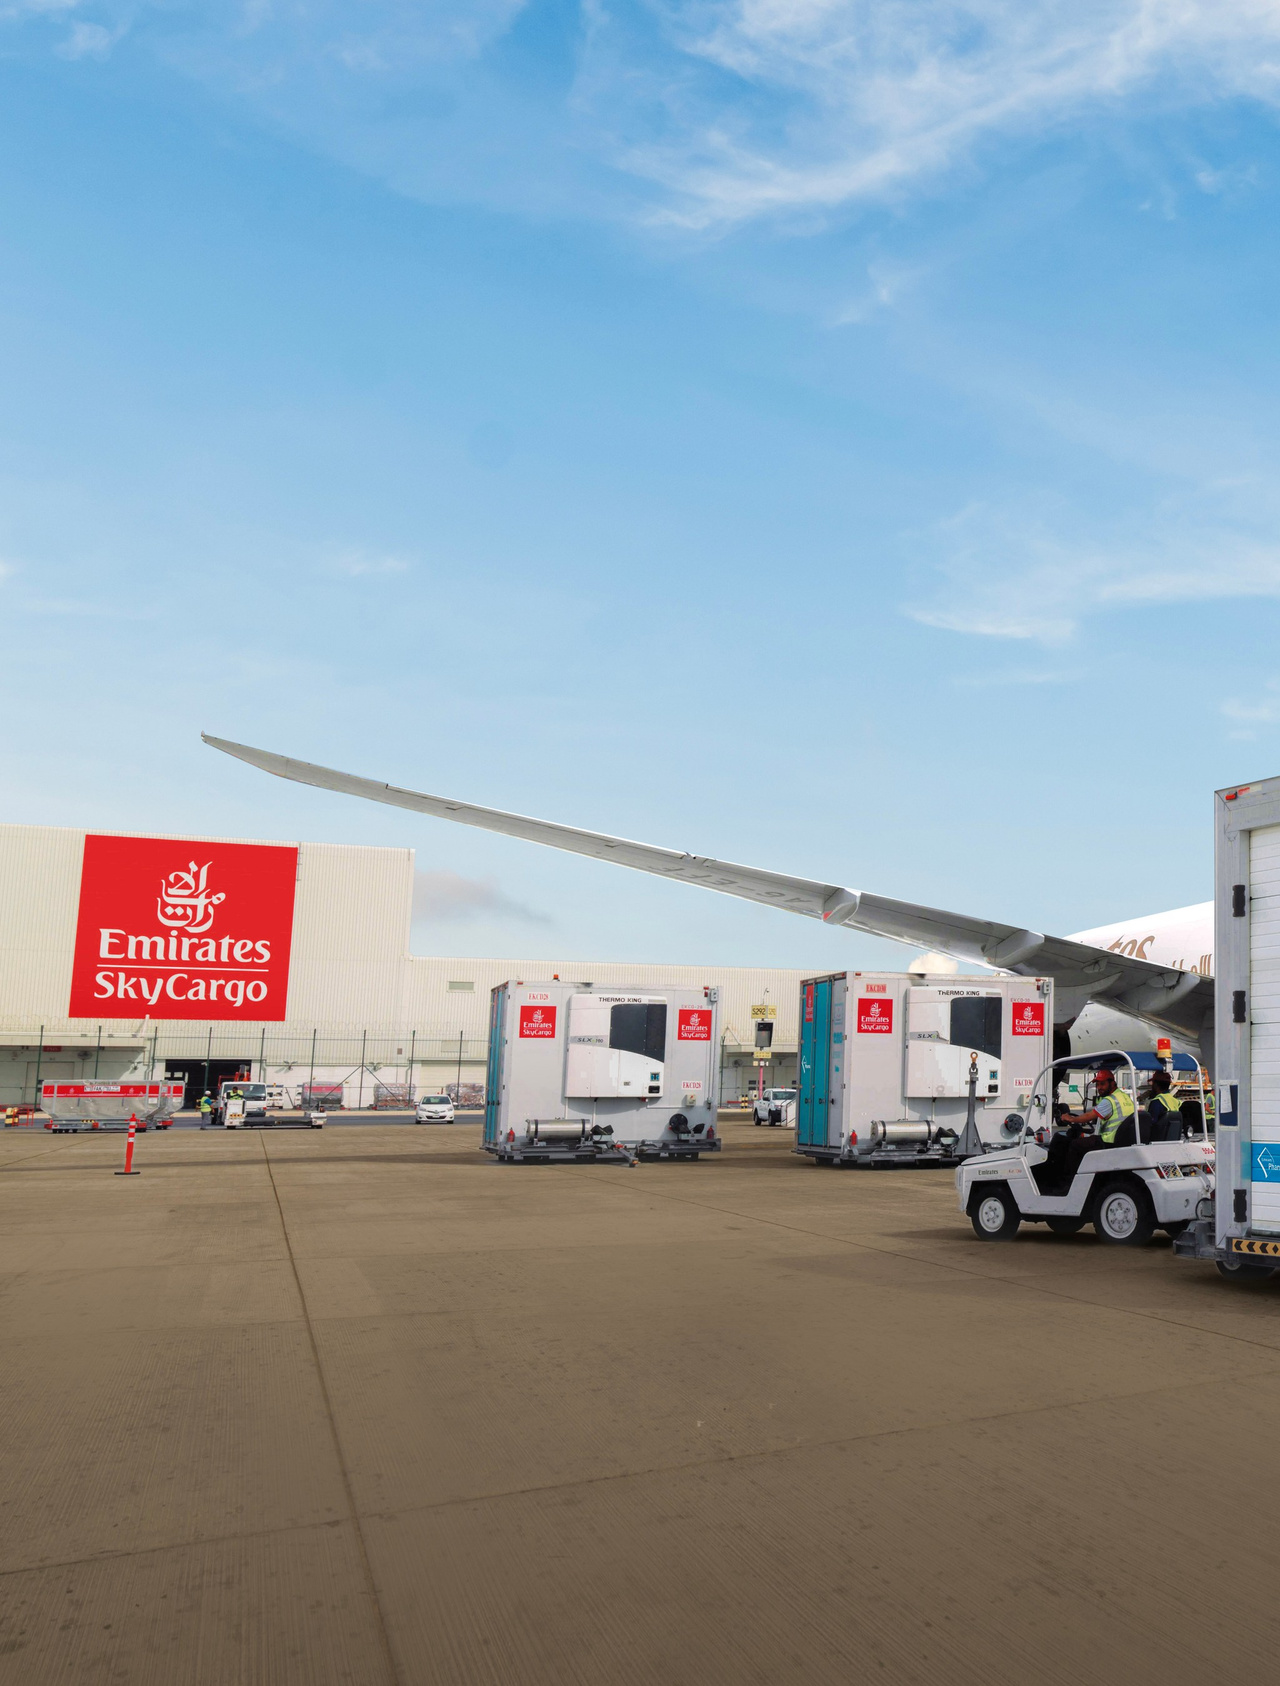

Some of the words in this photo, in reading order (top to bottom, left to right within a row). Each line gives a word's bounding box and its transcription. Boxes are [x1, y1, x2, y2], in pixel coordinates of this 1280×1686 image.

[99, 928, 271, 964] Emirates
[94, 971, 268, 1007] SkyCargo
[861, 1015, 889, 1023] Emirates
